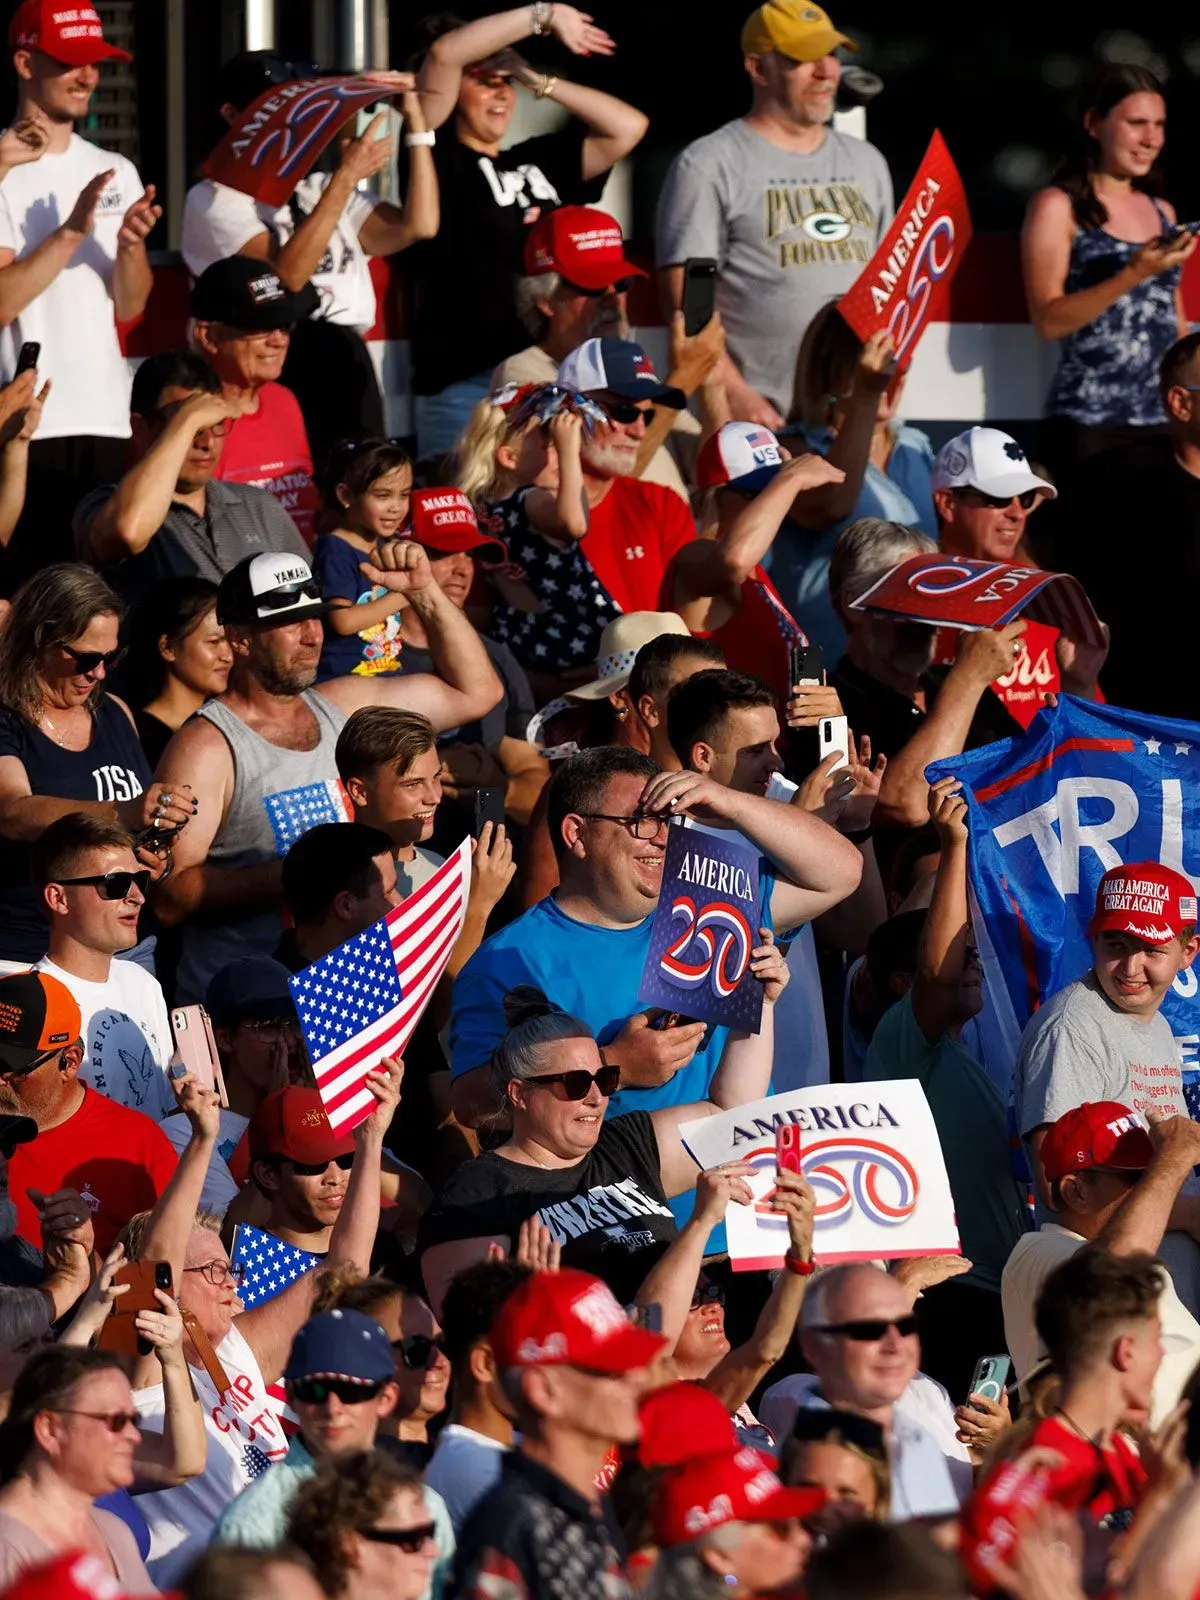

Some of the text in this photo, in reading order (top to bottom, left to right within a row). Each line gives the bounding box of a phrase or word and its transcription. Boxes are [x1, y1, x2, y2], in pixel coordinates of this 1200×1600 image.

[868, 176, 941, 314] AMERICA
[421, 495, 454, 512] MAKE
[433, 510, 466, 527] GREAT
[973, 566, 1044, 604] RICA
[92, 764, 144, 802] USA
[677, 851, 754, 902] AMERICA
[1103, 879, 1170, 902] MAKE AMERICA
[1104, 894, 1165, 916] GREAT AGAIN
[93, 1012, 131, 1091] MERICAN
[730, 1101, 900, 1147] AMERICA
